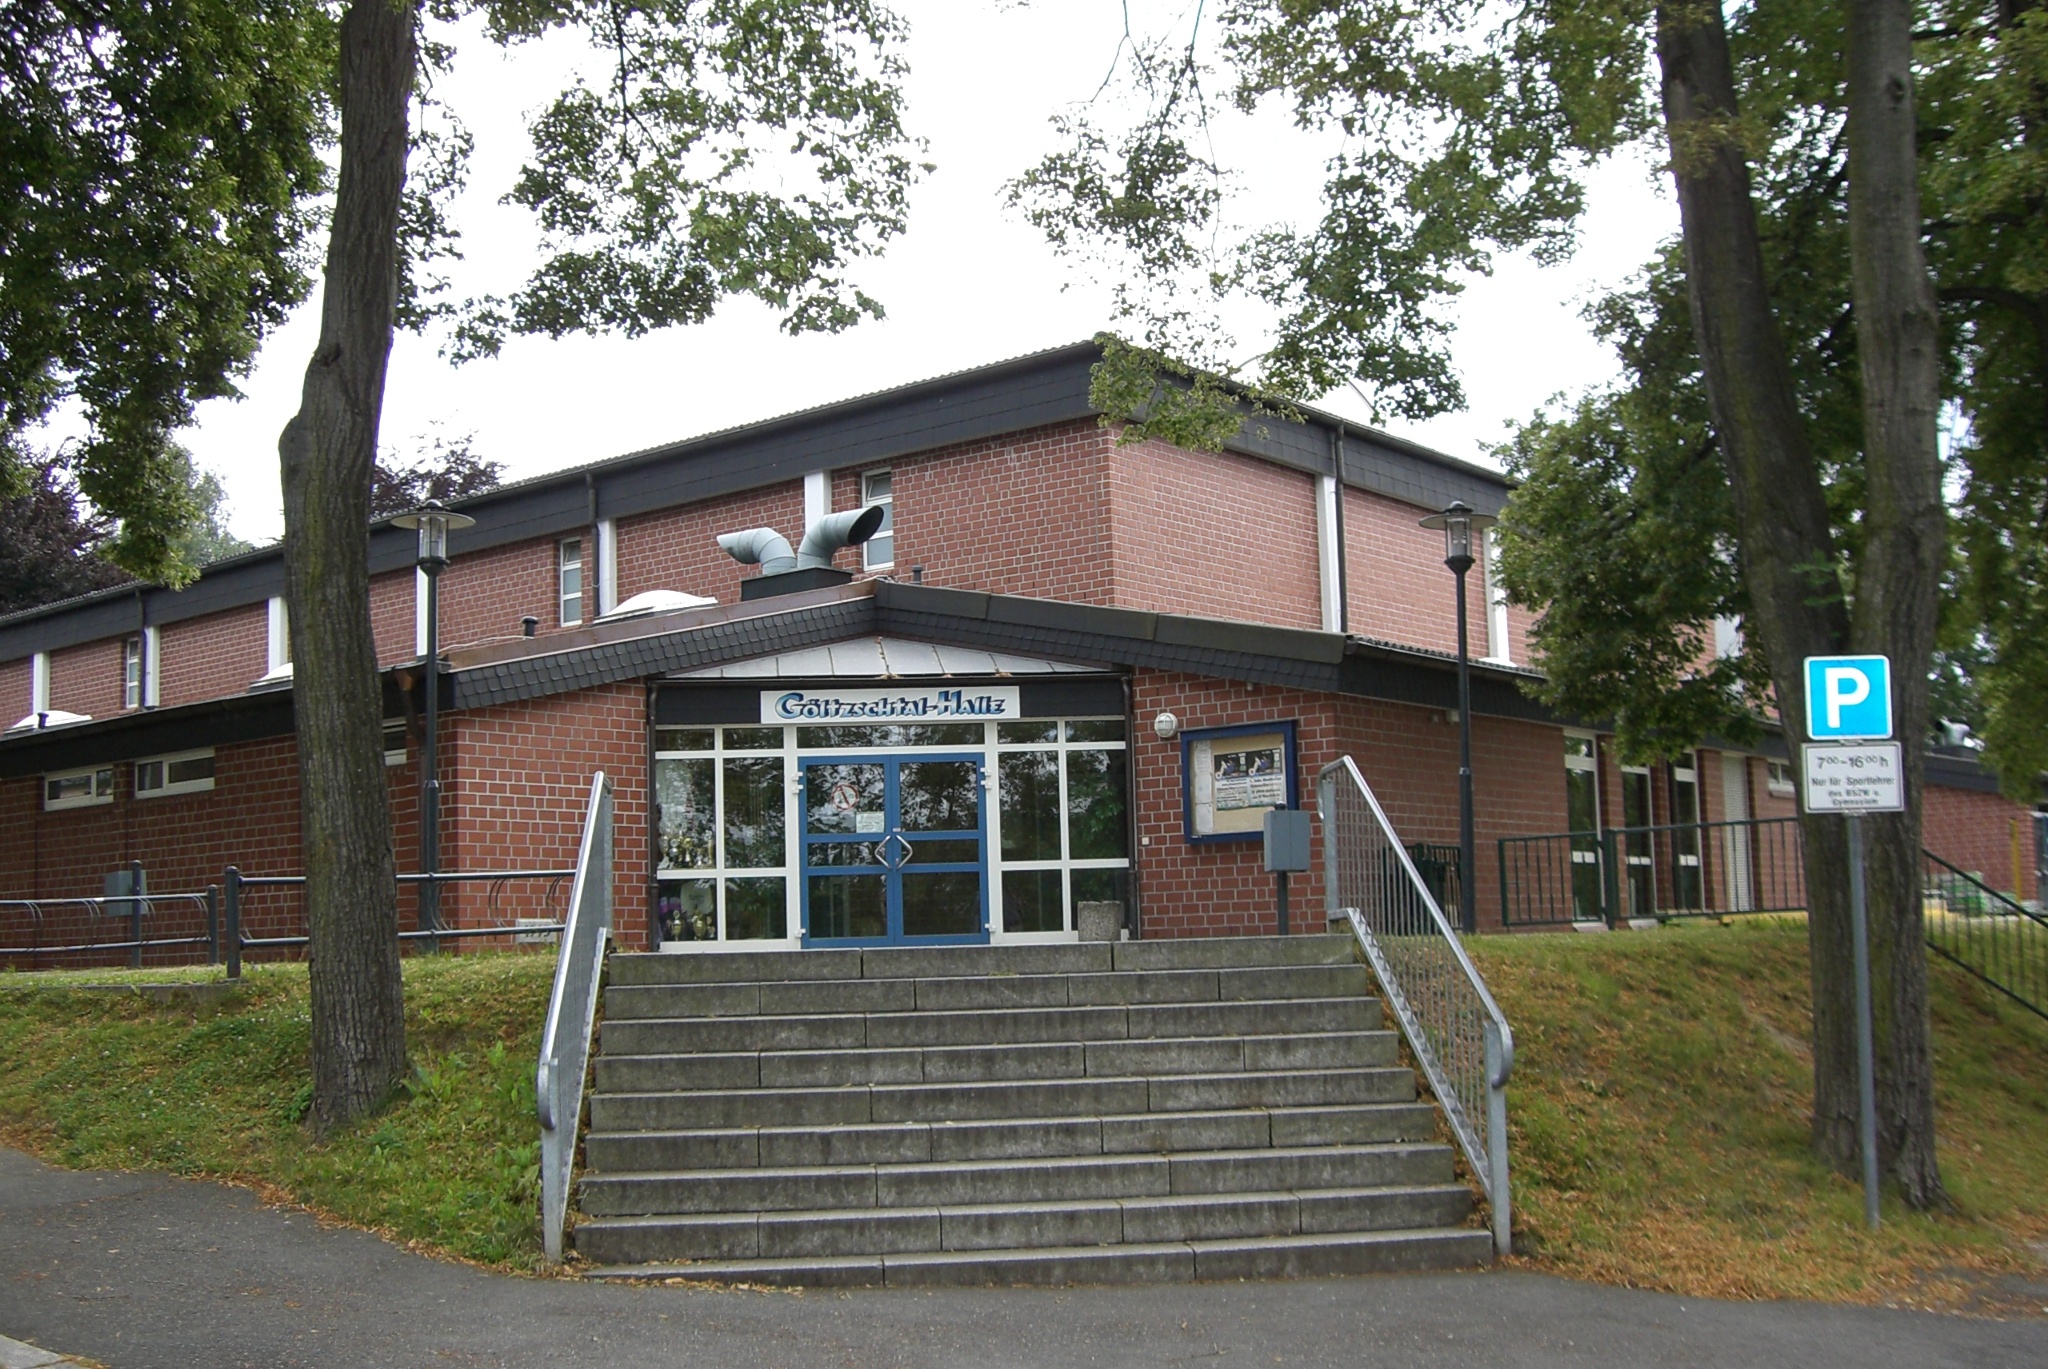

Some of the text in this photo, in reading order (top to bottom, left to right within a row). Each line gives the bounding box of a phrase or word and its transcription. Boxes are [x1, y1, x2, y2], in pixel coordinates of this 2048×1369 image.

[1825, 667, 1870, 728] P
[1812, 775, 1895, 787] Nur für Sportlehrer
